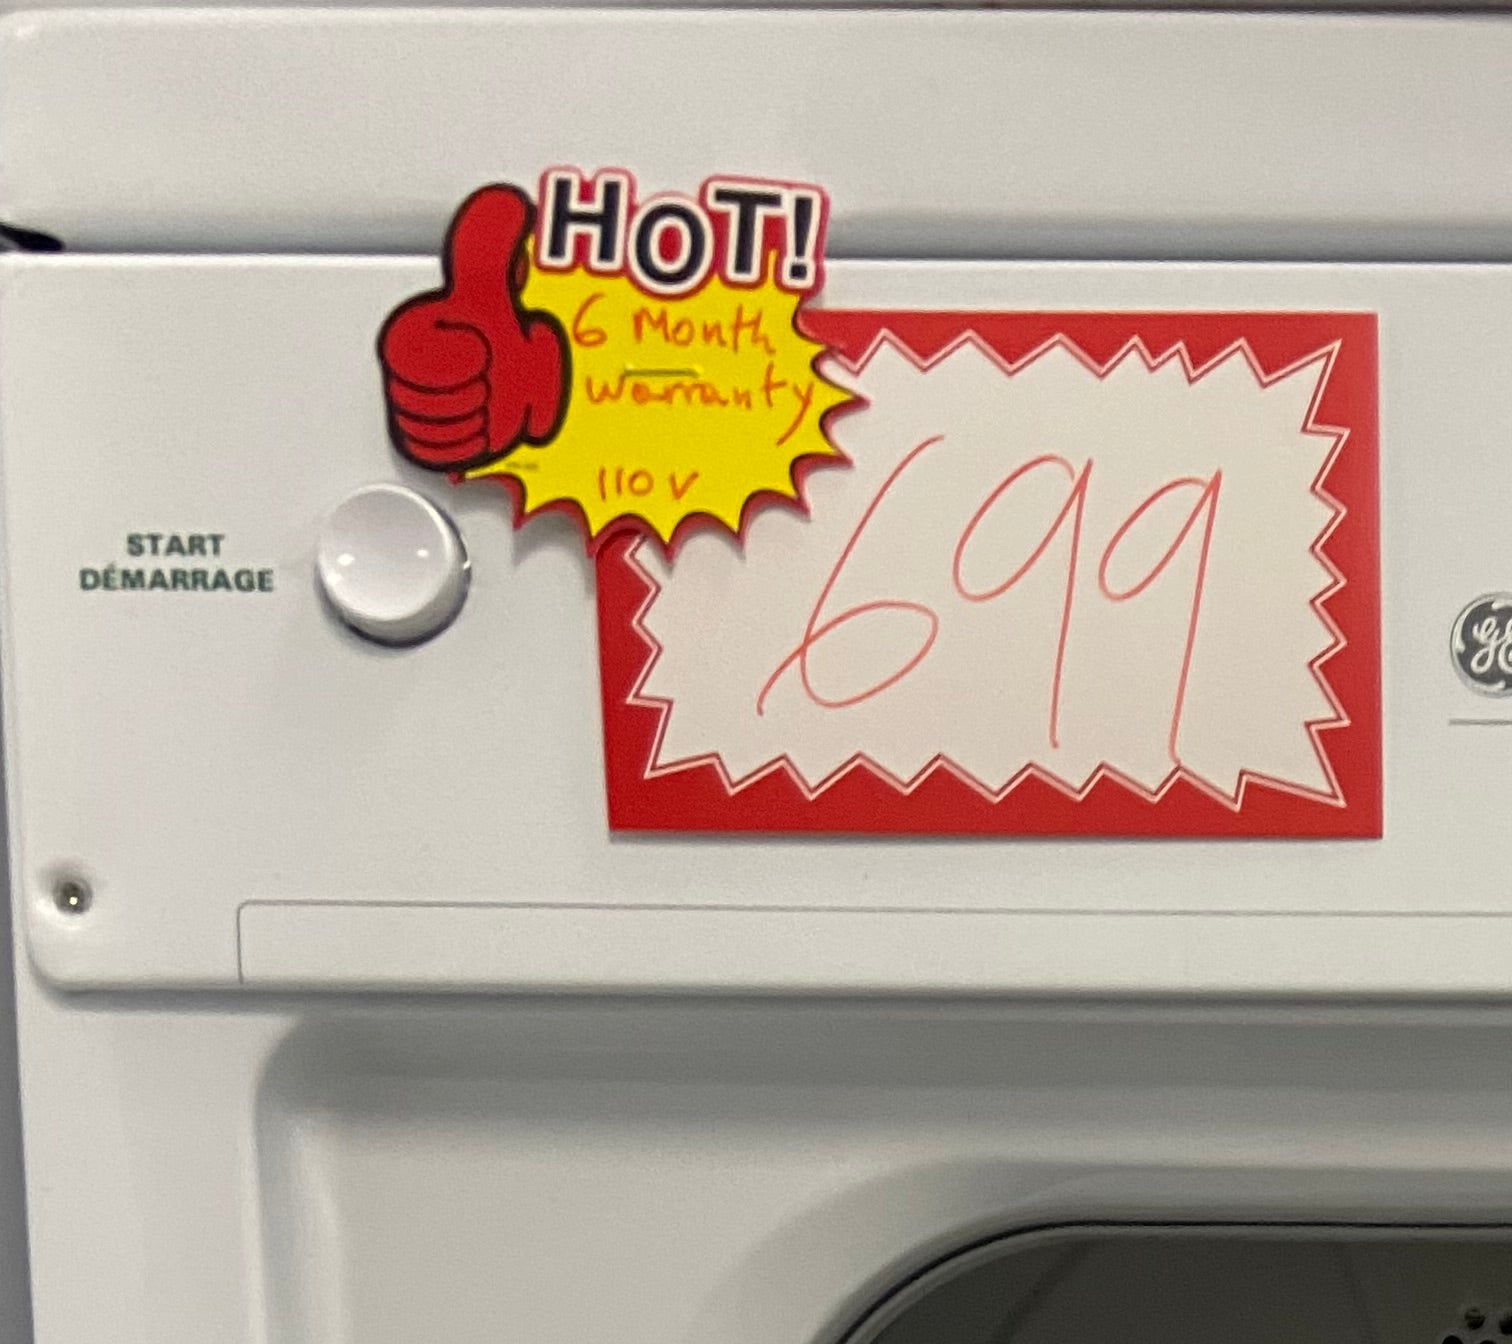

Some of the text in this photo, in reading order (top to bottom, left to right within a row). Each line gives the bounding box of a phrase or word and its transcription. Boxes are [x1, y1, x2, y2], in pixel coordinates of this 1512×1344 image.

[546, 176, 815, 287] HOT!
[571, 291, 777, 356] 6 Month
[598, 466, 656, 502] 110
[126, 532, 226, 558] START
[78, 562, 275, 593] DÉMARRAGE
[756, 433, 1224, 767] 699
